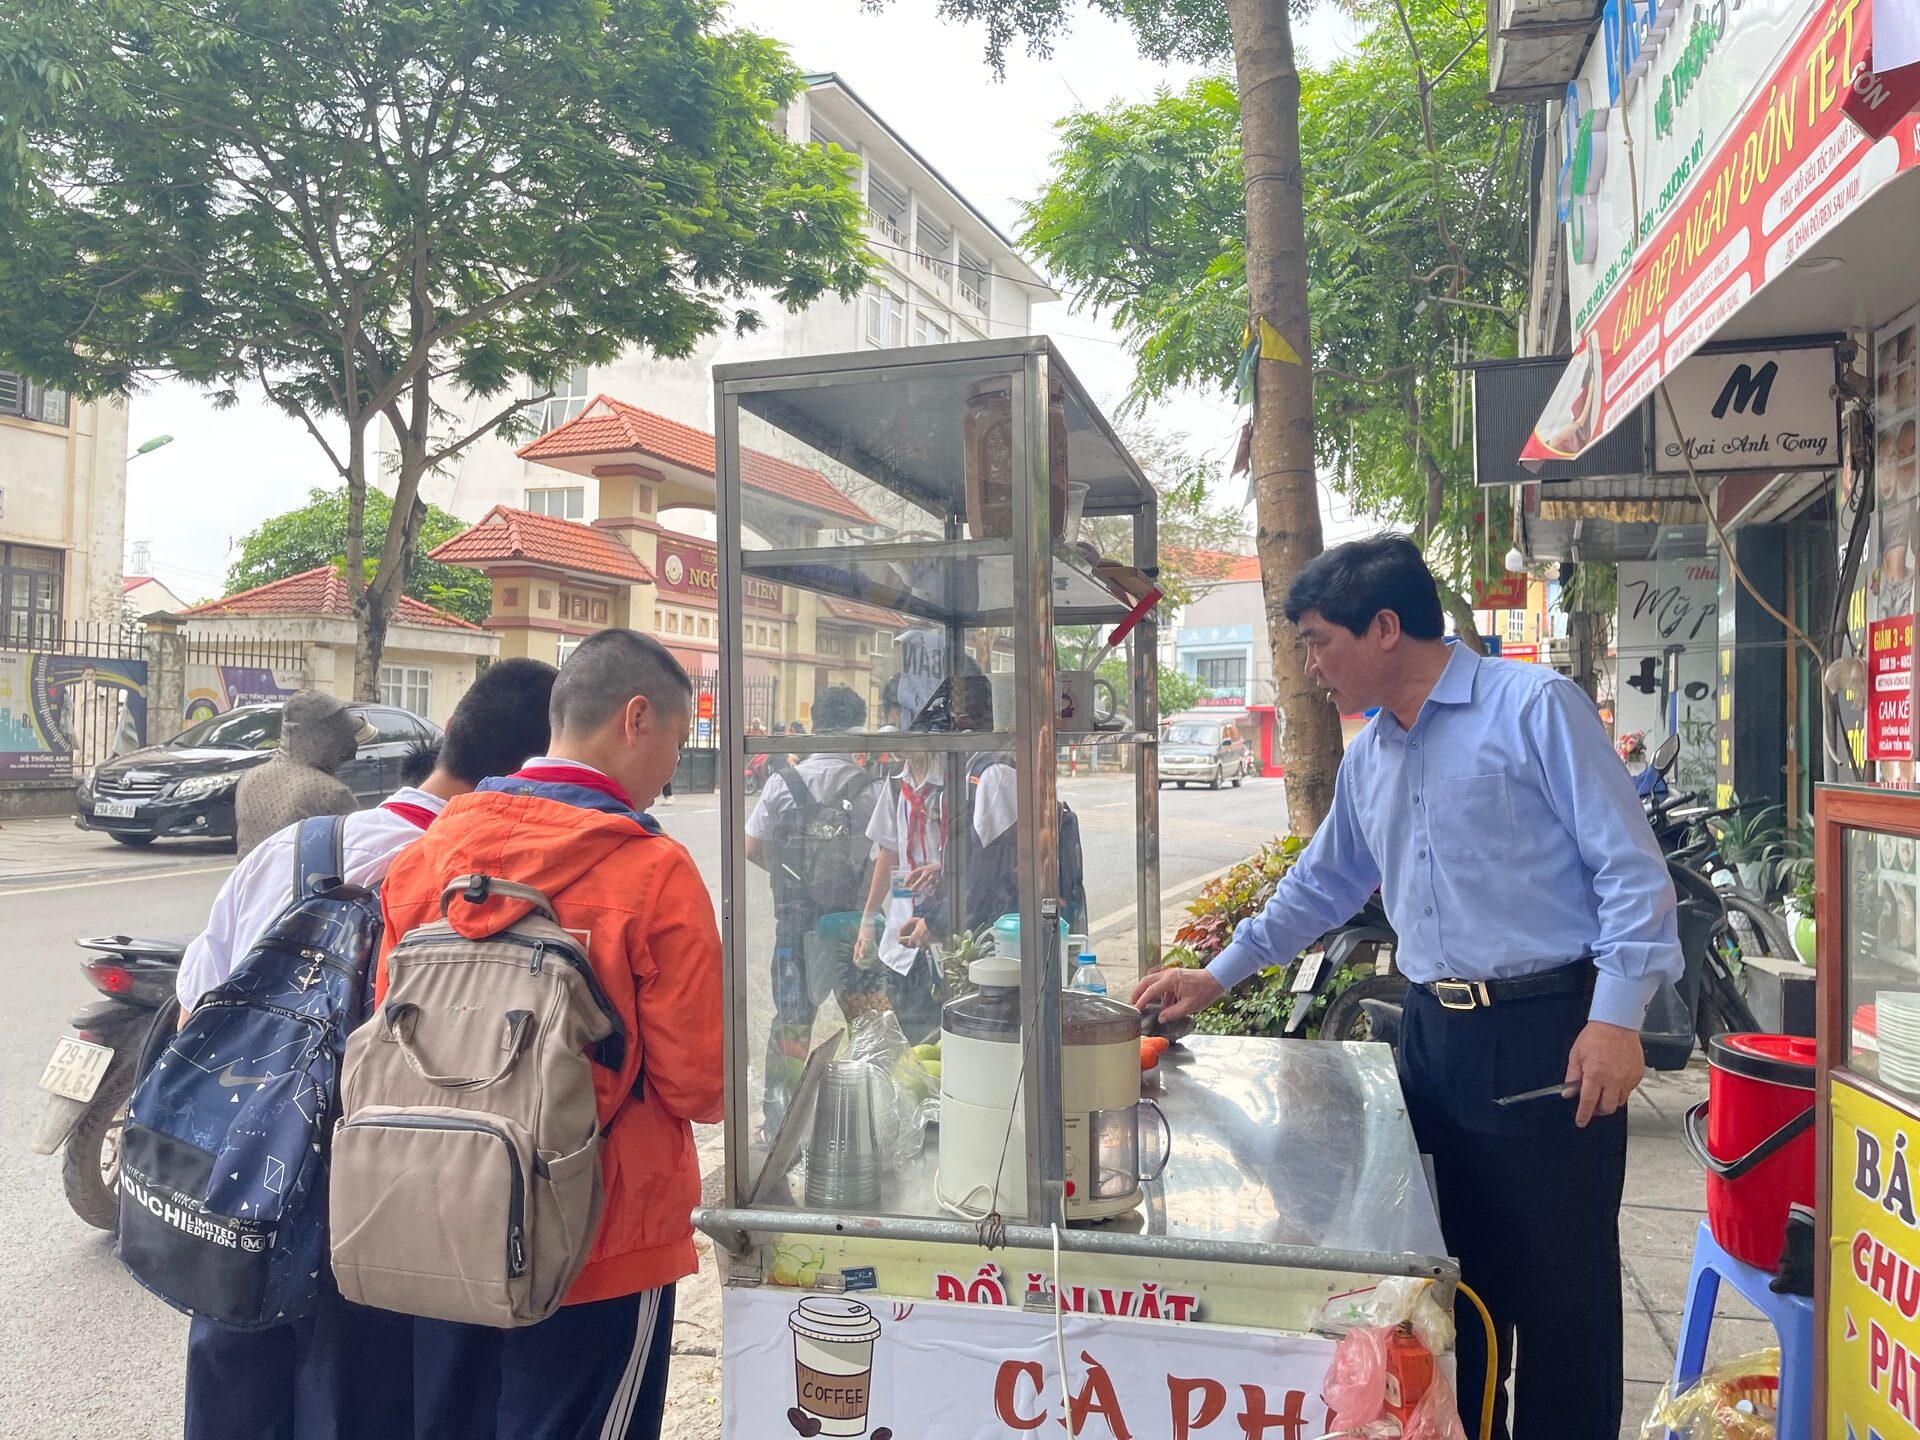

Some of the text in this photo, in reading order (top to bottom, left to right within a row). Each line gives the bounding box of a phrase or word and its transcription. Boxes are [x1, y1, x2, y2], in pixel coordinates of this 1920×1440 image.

[1612, 276, 1647, 356] LÀM
[1645, 231, 1680, 315] ĐẸP
[1680, 152, 1738, 277] NGAY
[1739, 75, 1798, 205] ĐÓN
[1805, 0, 1861, 128] TẾT
[1711, 360, 1778, 419] M
[1665, 433, 1716, 461] Mai
[1722, 434, 1769, 455] Anh
[1892, 628, 1899, 649] 3
[1878, 701, 1897, 720] CAM
[125, 1164, 145, 1181] NIKE
[170, 1191, 199, 1210] NIKE
[186, 1225, 237, 1249] EDITION
[187, 1216, 237, 1239] LIMITED
[803, 1382, 863, 1404] COFFEE
[994, 1350, 1332, 1440] CÀ PH
